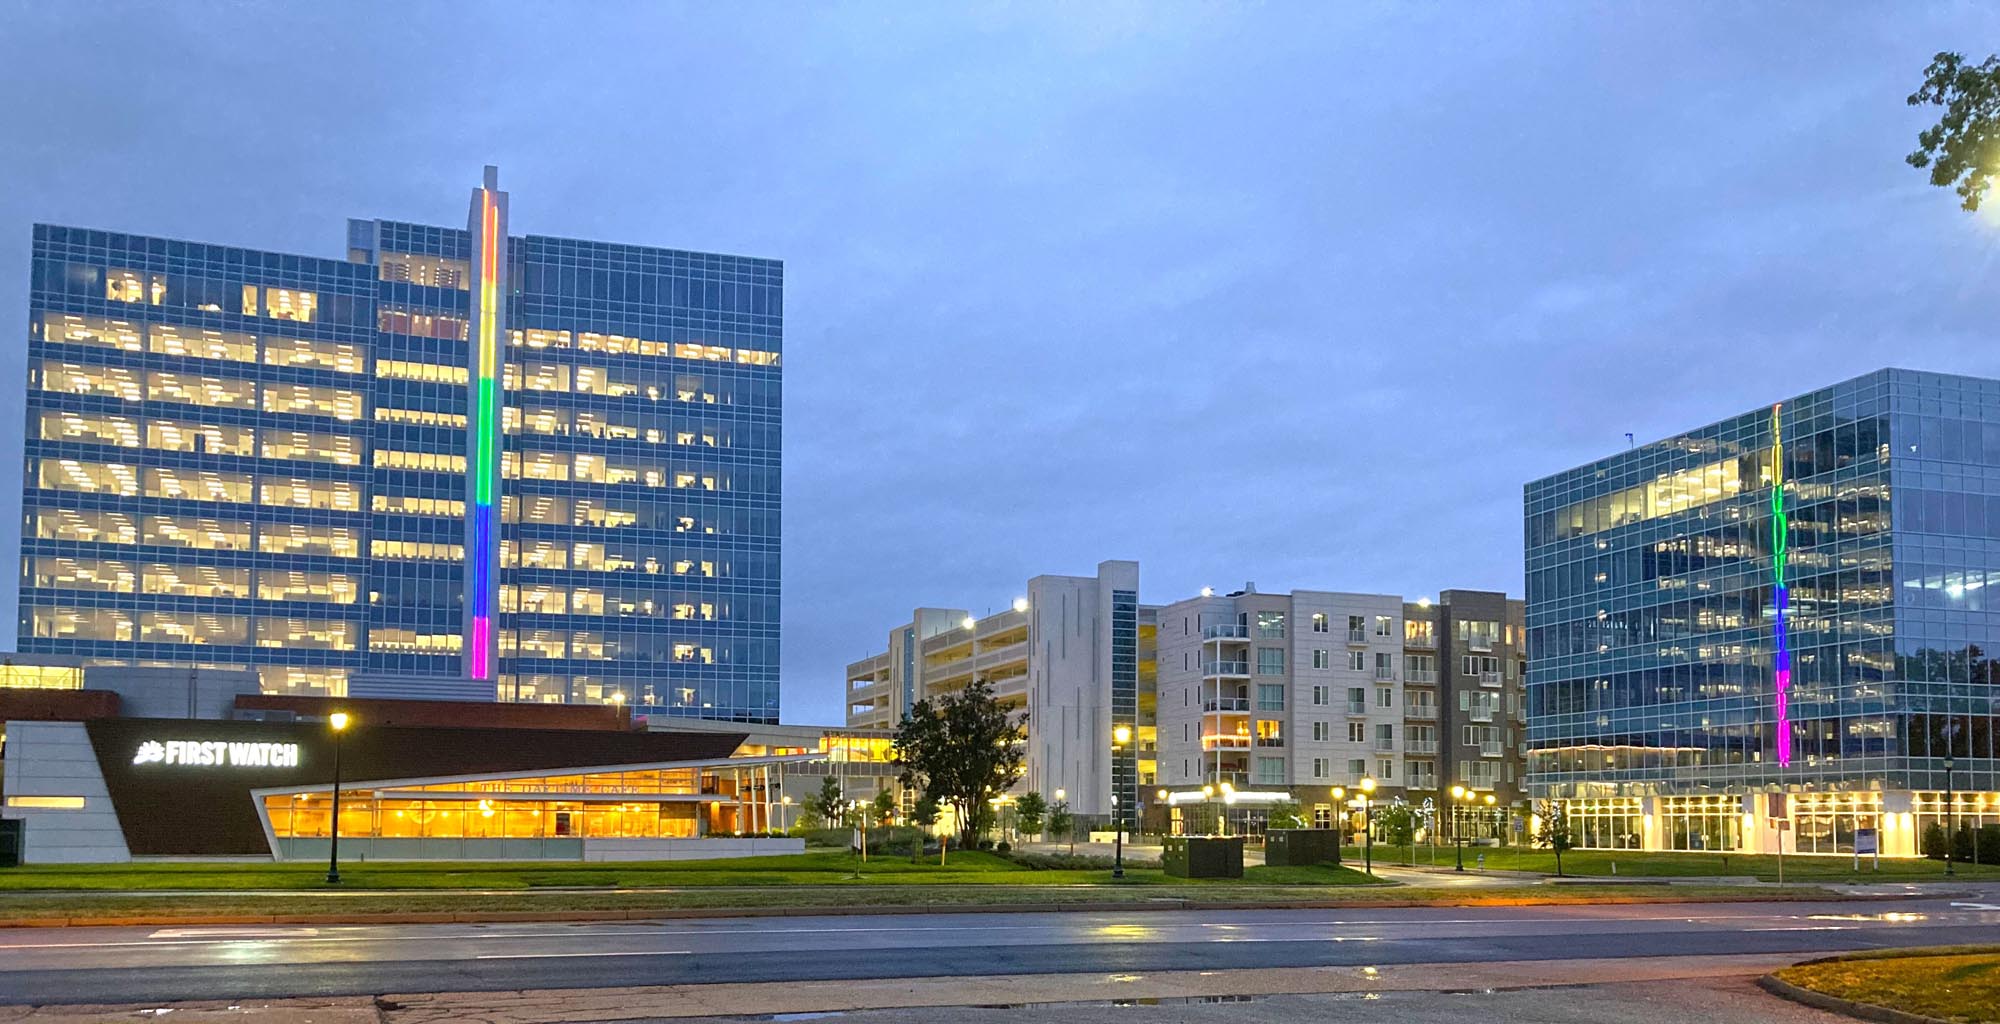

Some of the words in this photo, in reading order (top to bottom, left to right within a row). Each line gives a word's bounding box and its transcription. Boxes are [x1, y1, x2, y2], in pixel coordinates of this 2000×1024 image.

[165, 740, 228, 766] FIRST
[228, 742, 298, 767] WATCH
[480, 783, 512, 793] THE
